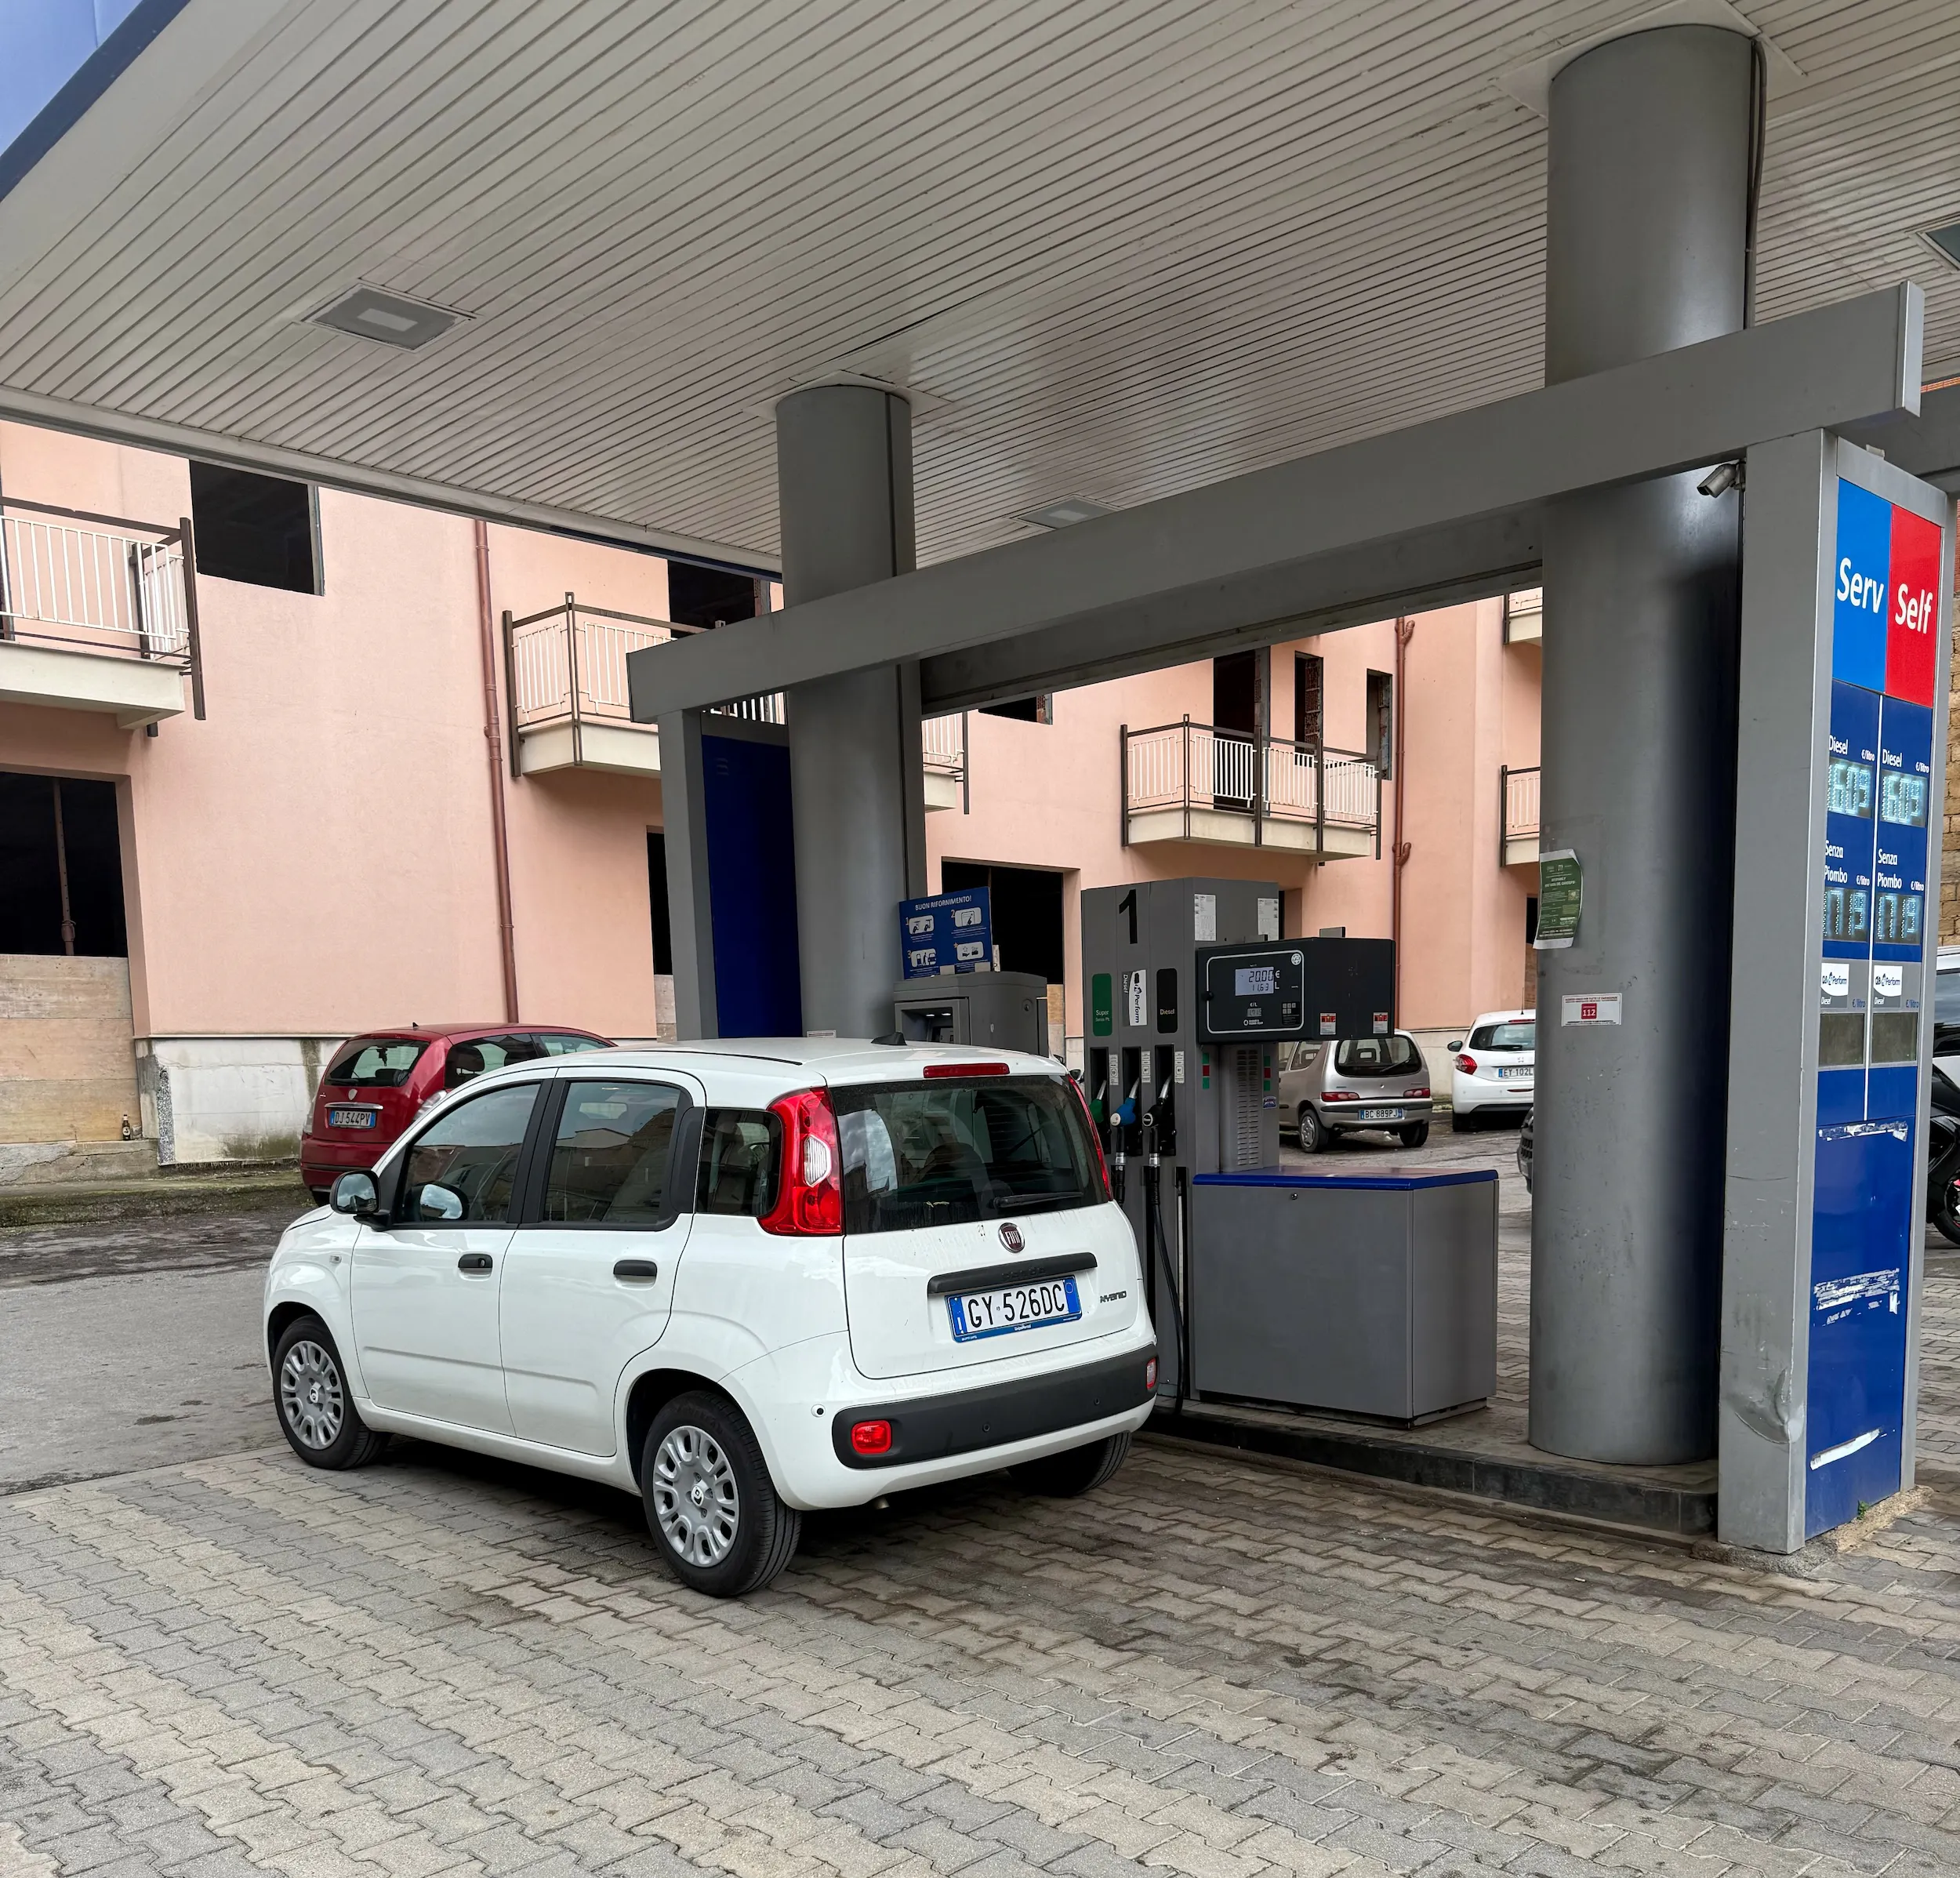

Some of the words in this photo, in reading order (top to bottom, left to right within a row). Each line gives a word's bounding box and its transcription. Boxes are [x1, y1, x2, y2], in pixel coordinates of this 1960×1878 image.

[1837, 557, 1884, 613] Serv
[1895, 583, 1933, 634] Self
[1828, 735, 1849, 755] Diesel
[1882, 748, 1903, 768] Diesel
[1825, 840, 1844, 859] Senza
[1878, 848, 1898, 866] Senza
[1824, 864, 1848, 884] Piombo
[1877, 872, 1903, 889] Piombo
[915, 903, 930, 911] BUON
[931, 895, 972, 908] RIFORNIMENTO!
[1119, 889, 1138, 944] 1
[1582, 1008, 1596, 1017] 112
[1004, 1230, 1021, 1244] FIAT
[967, 1295, 994, 1328] GY
[1002, 1284, 1065, 1321] 526DC
